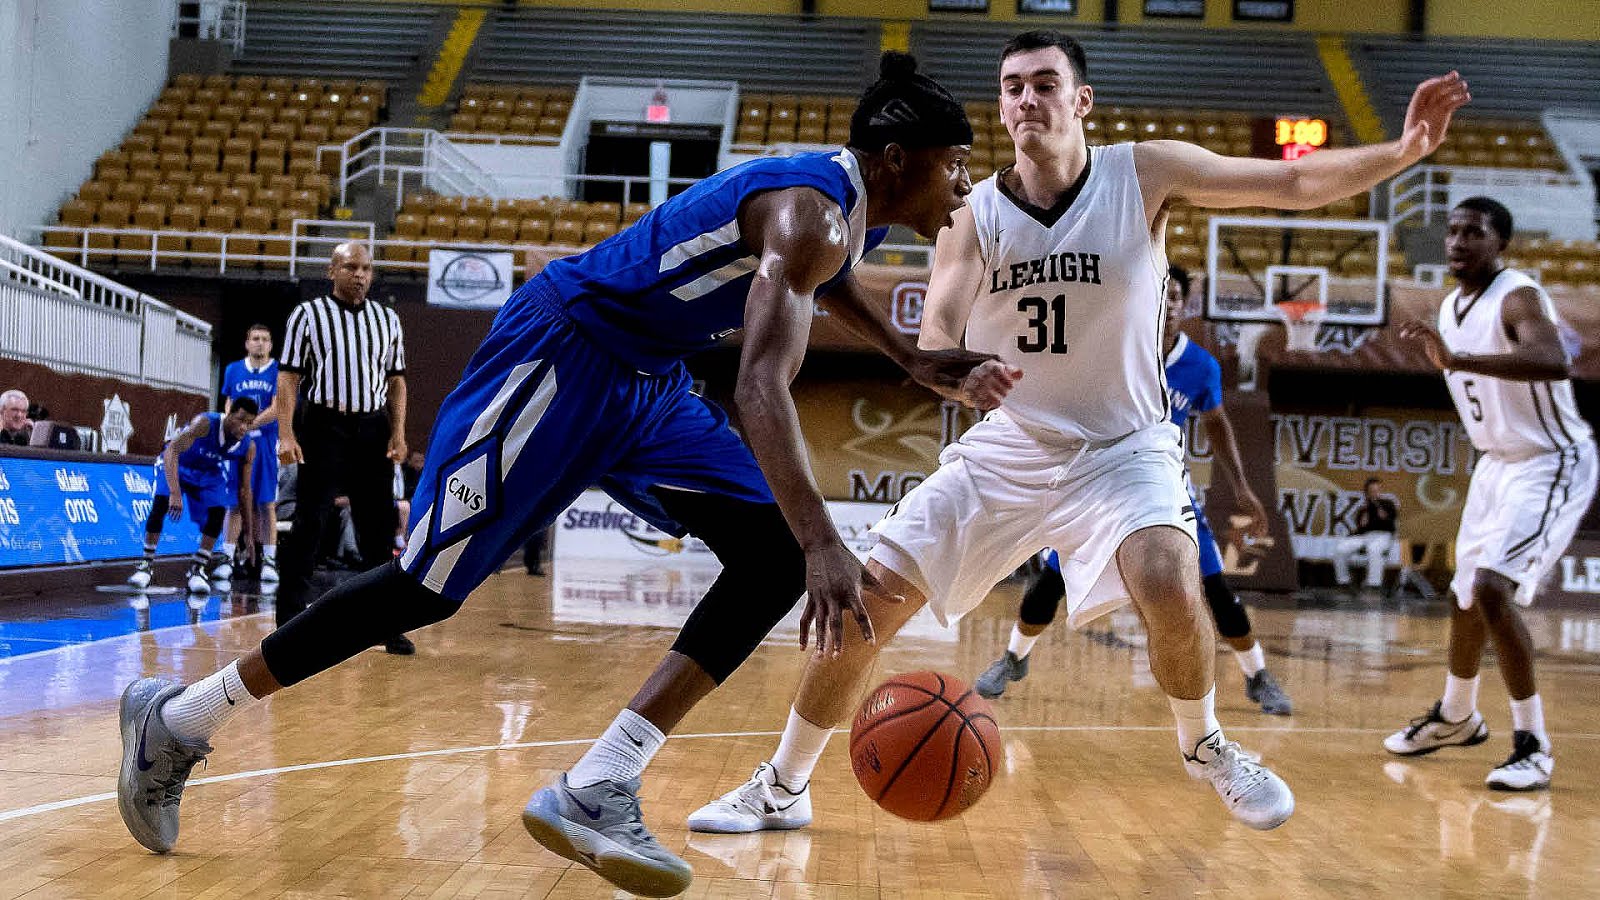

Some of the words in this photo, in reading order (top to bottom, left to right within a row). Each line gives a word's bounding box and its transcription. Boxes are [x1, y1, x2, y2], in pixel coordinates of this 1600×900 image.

[990, 252, 1101, 294] LEHIGH
[1017, 293, 1068, 354] 31
[1463, 380, 1483, 422] 5
[65, 498, 99, 524] oms
[448, 477, 483, 511] CAVS
[563, 507, 640, 531] SERVICE
